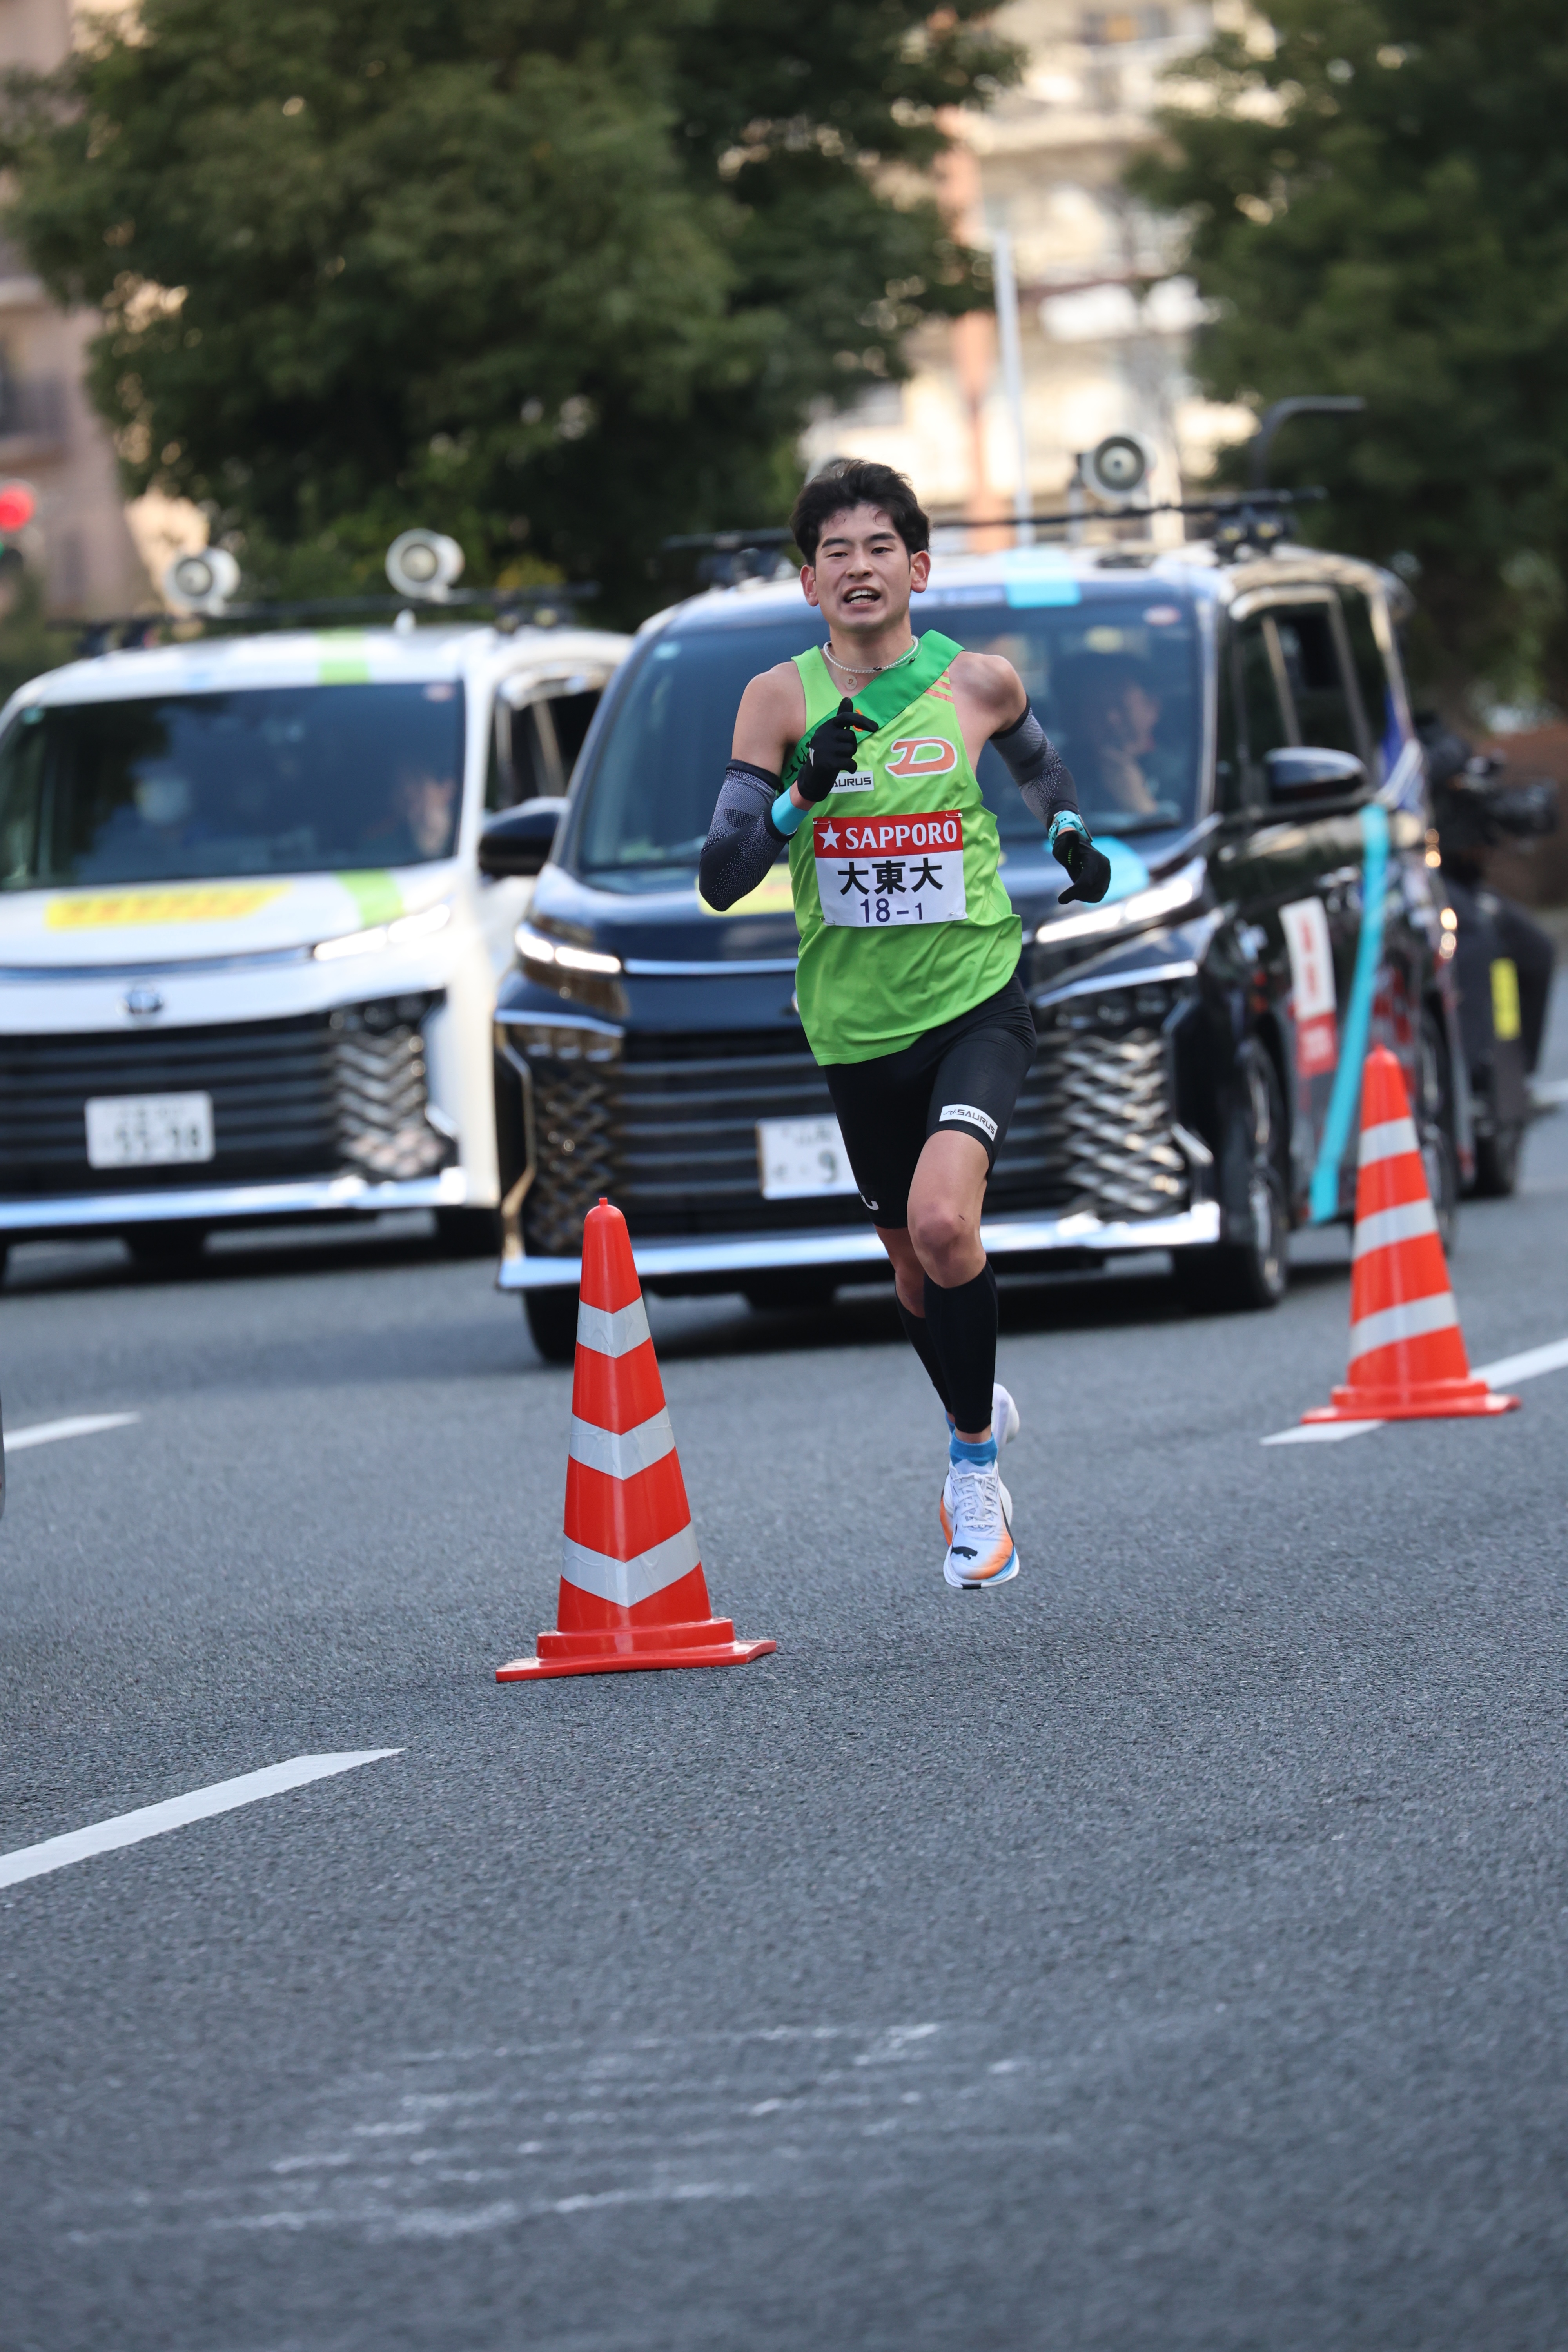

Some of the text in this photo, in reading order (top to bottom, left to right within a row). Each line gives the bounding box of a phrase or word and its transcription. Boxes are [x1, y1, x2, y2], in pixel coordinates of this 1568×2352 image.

[885, 737, 958, 778] D
[846, 820, 957, 850] SAPPORO
[837, 857, 944, 896] 大東大
[957, 1109, 995, 1136] SAURUS
